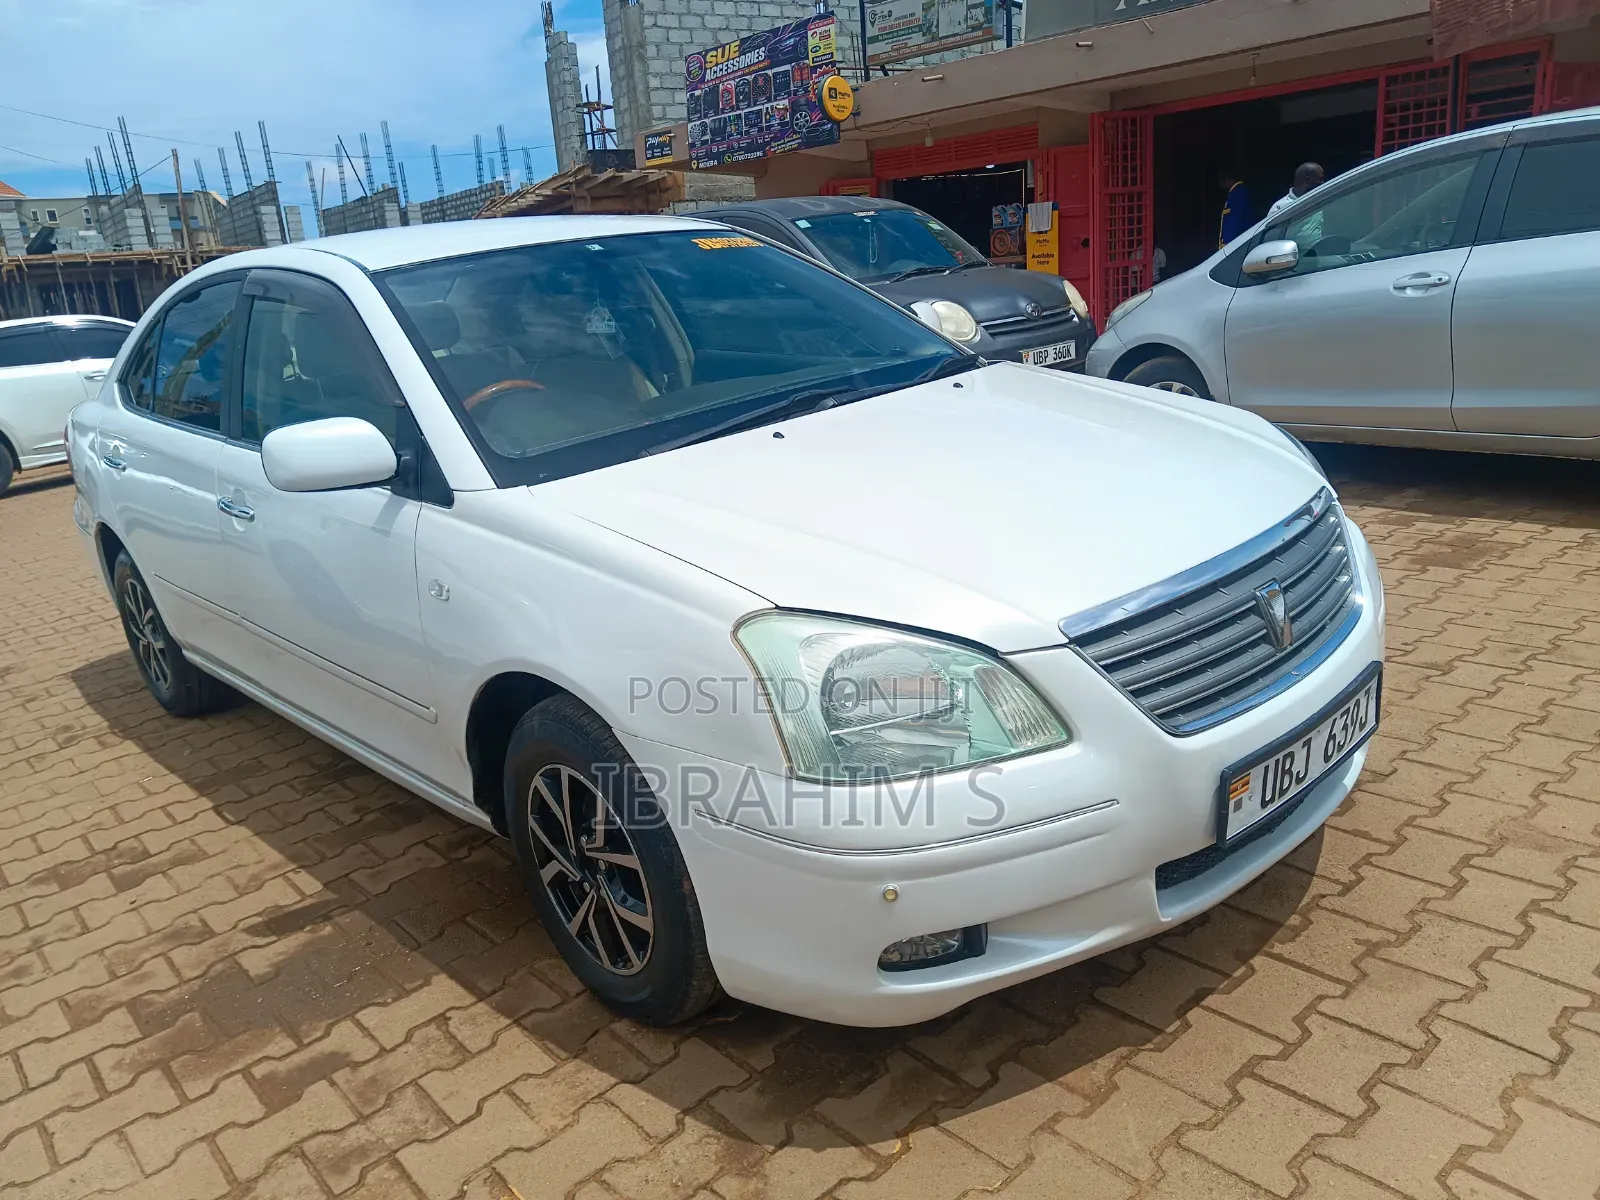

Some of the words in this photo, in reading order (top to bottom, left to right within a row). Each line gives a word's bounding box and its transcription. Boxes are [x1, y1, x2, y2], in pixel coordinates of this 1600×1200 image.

[705, 47, 766, 82] ACCESSORIES
[706, 40, 740, 68] SUE
[1033, 350, 1048, 365] UBP
[1053, 344, 1072, 360] 360K
[1260, 736, 1312, 810] UBJ
[1323, 686, 1371, 764] 639J
